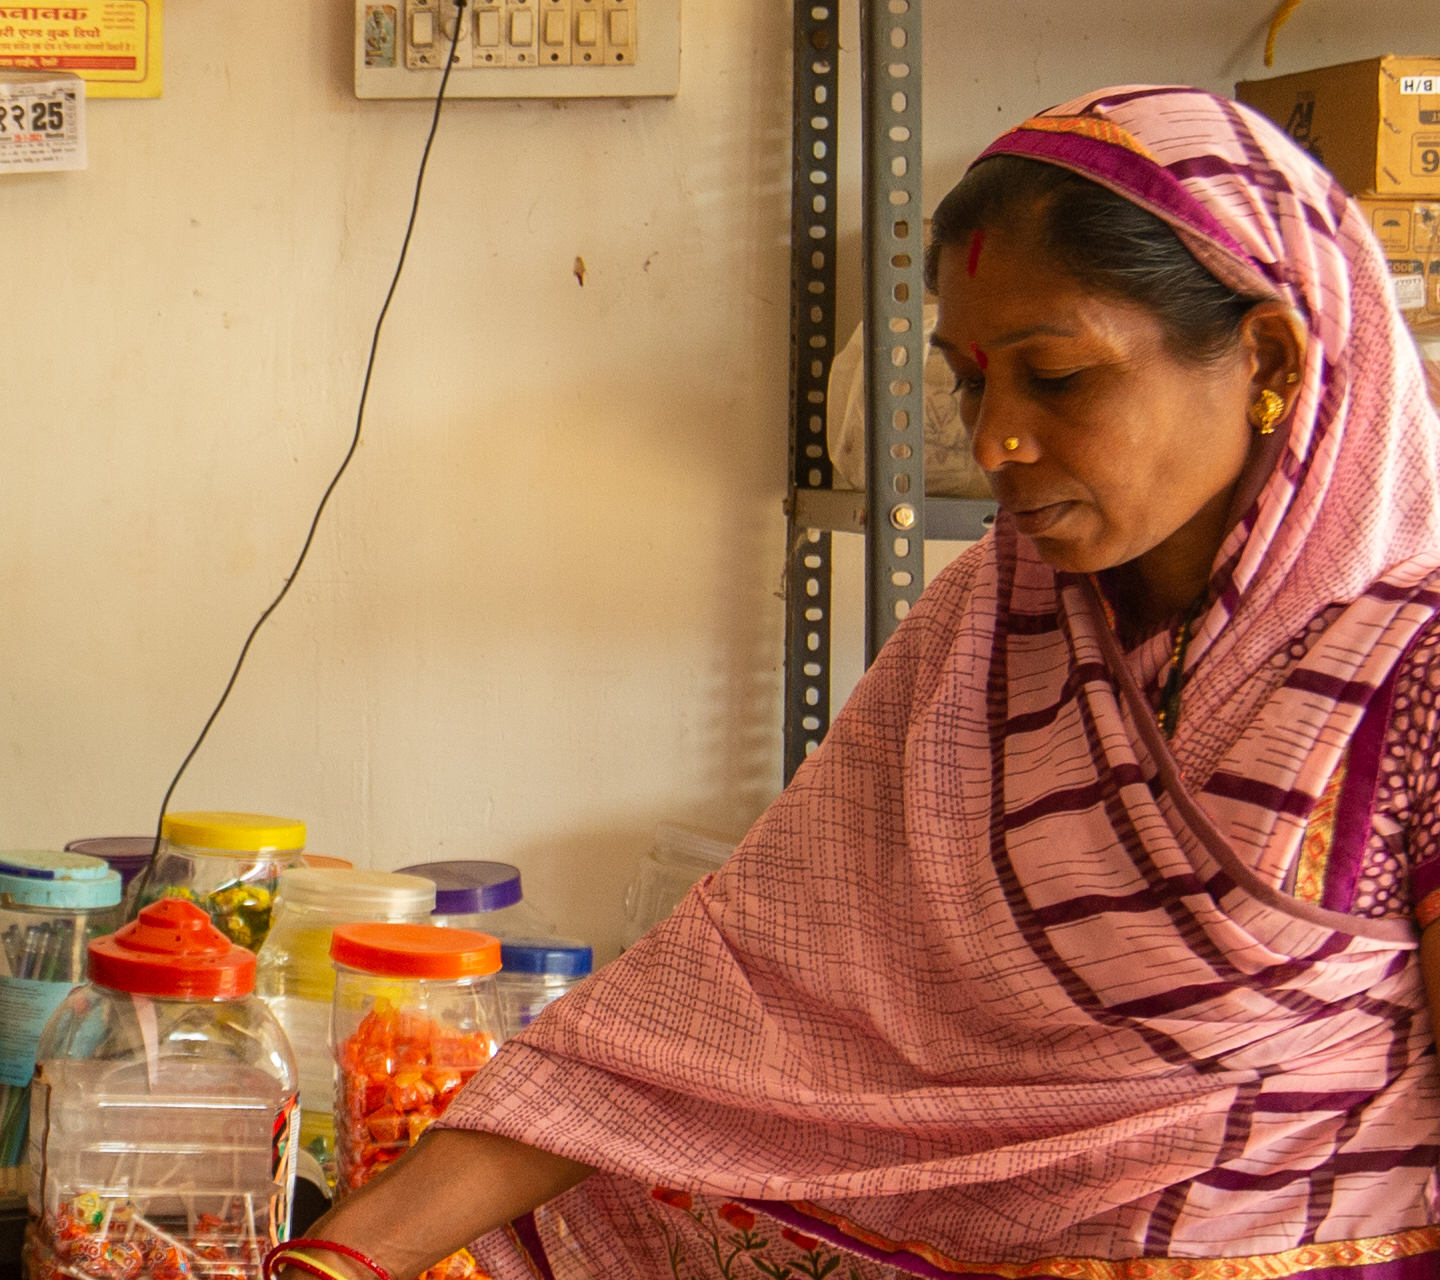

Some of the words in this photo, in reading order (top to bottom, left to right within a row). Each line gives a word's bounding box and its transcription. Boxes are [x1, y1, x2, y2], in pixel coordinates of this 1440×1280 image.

[1403, 79, 1433, 92] B/H
[31, 101, 64, 131] 25
[1390, 263, 1415, 273] ODE
